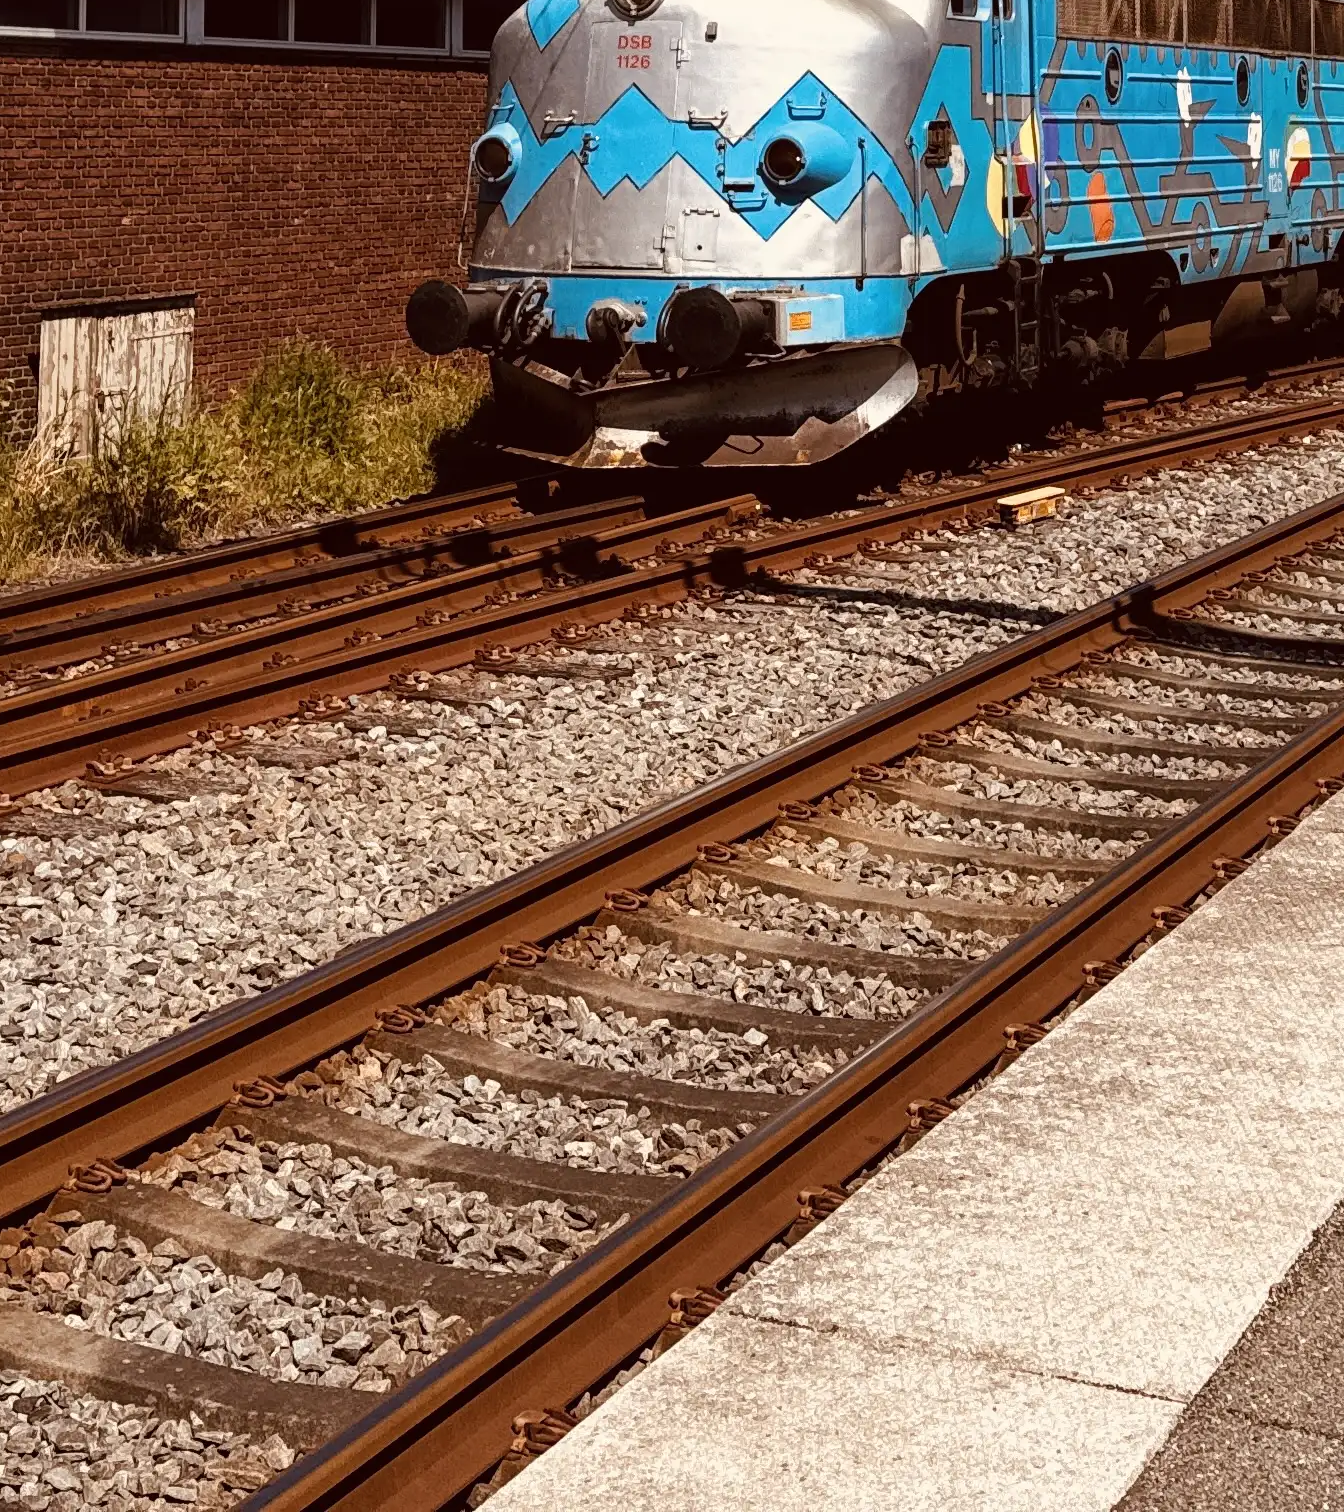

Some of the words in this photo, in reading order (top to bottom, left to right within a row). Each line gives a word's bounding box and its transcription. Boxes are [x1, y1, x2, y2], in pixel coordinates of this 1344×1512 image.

[617, 35, 652, 50] DSB
[616, 54, 650, 69] 1126
[1269, 148, 1280, 168] MY
[1268, 172, 1283, 192] 1126
